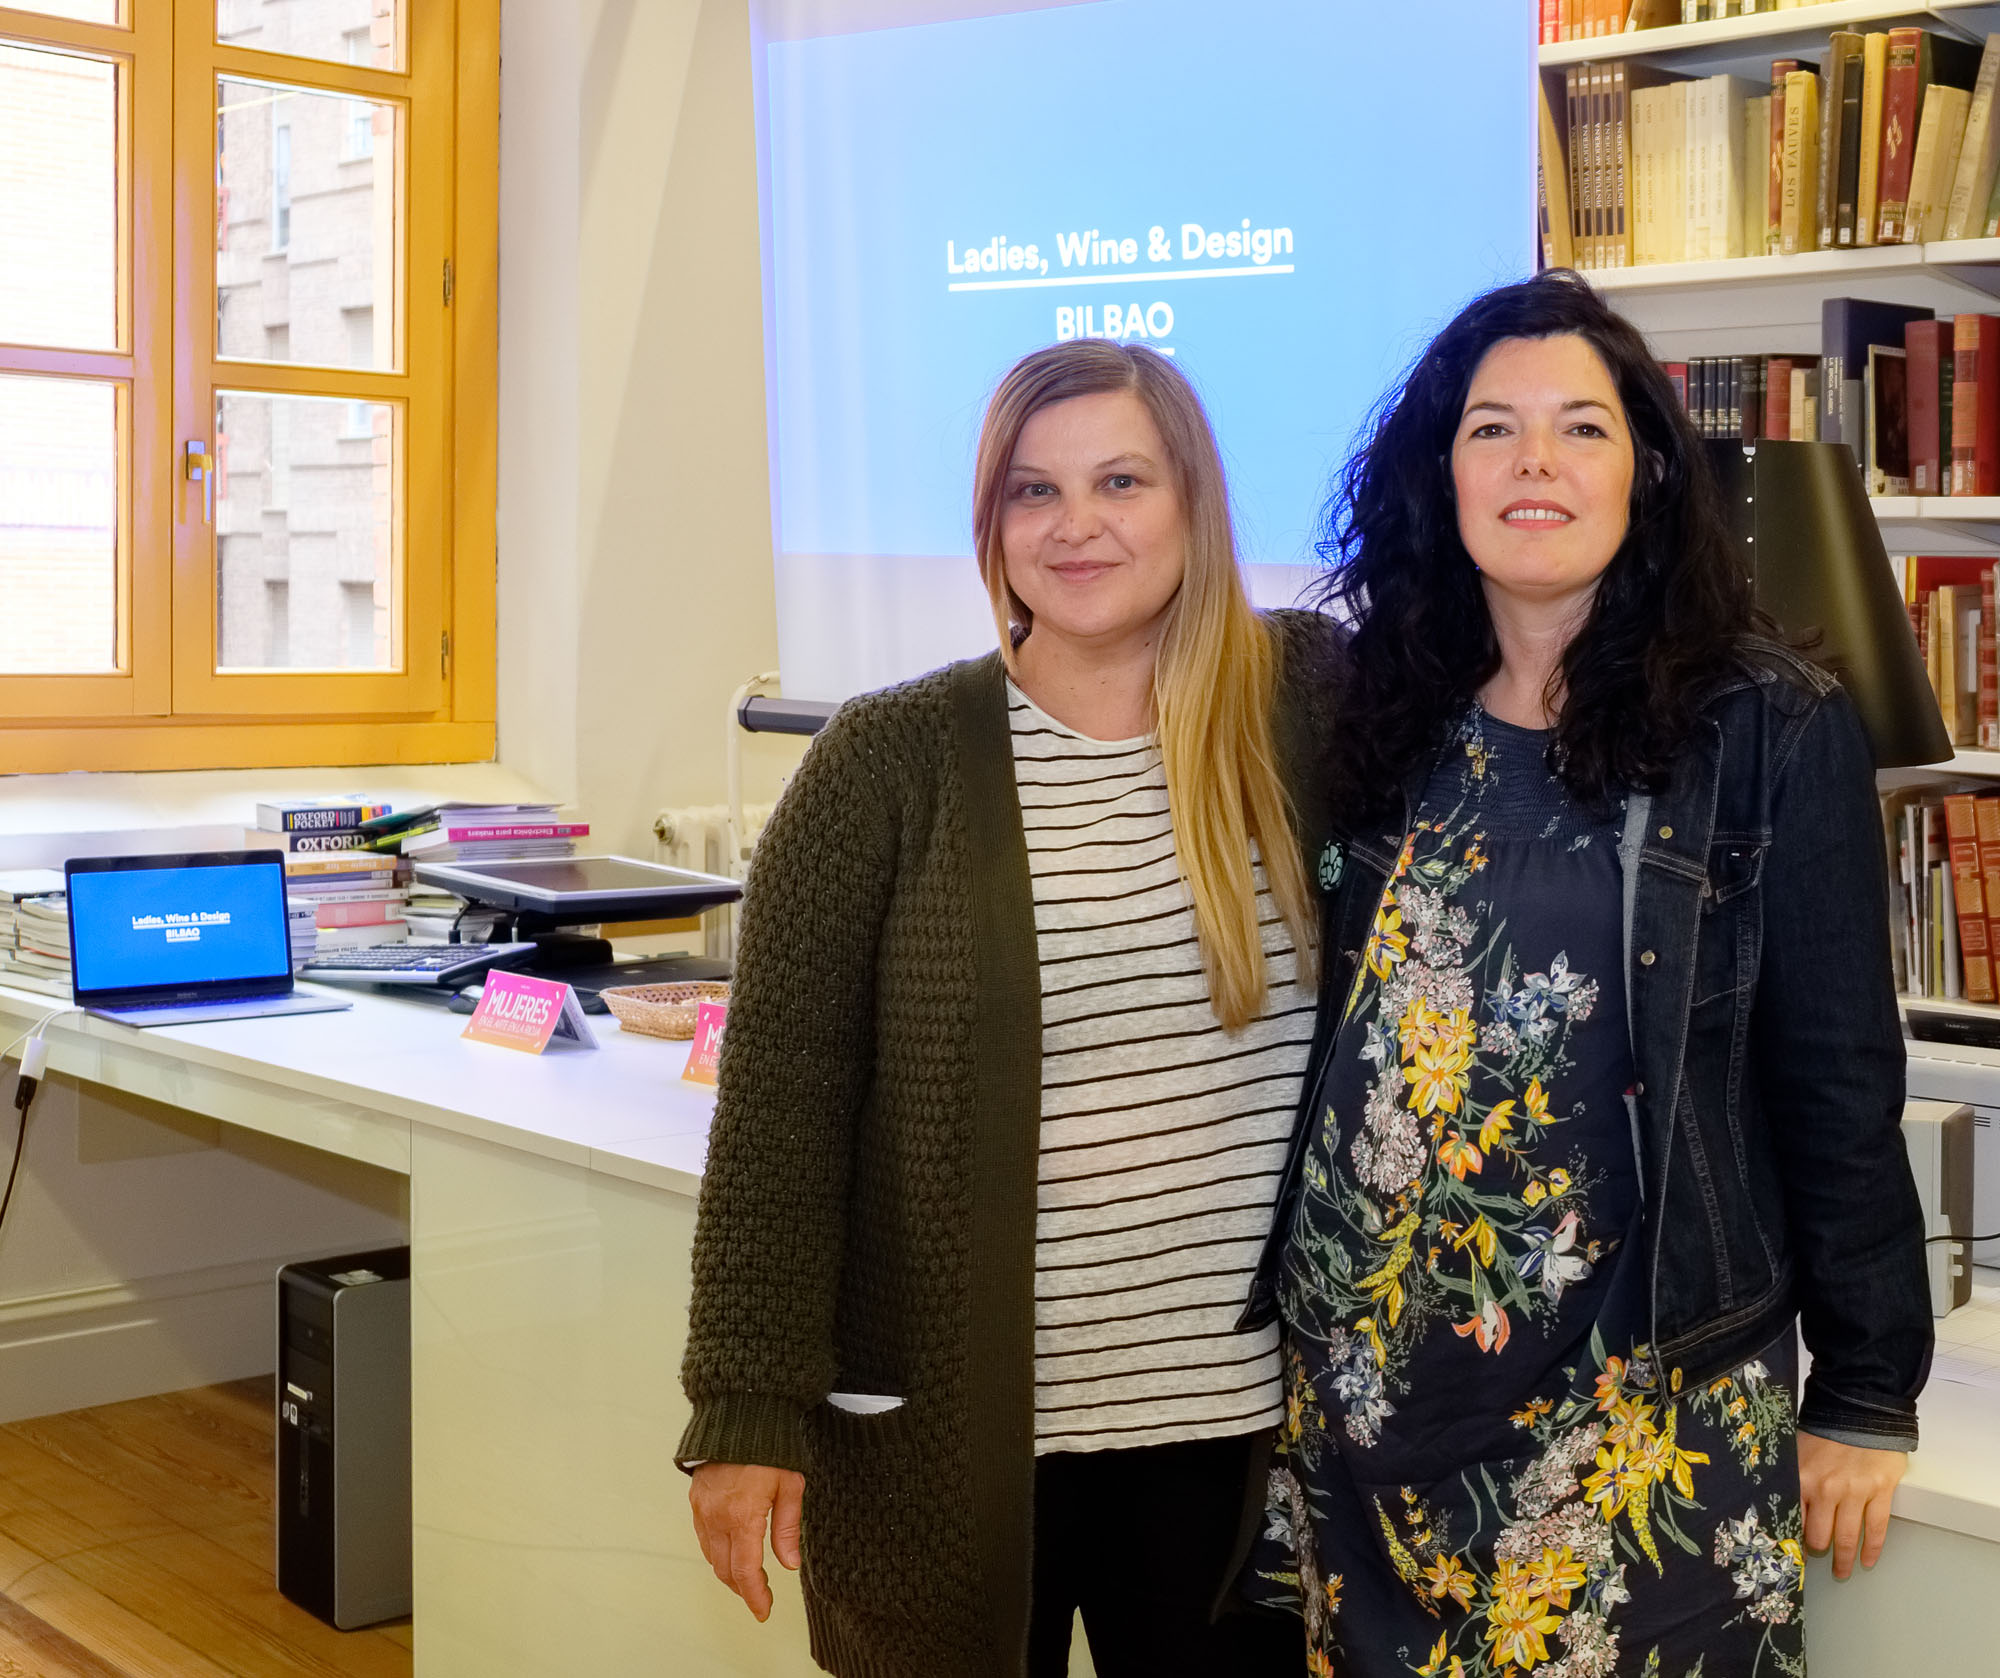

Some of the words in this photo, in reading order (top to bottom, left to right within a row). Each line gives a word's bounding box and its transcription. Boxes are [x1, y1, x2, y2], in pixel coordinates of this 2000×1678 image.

[1582, 123, 1590, 167] MODERNA
[1788, 105, 1800, 169] FAUVES
[1583, 170, 1591, 209] PINTURA
[1787, 177, 1797, 208] LOS
[947, 235, 1049, 276] Ladies,
[1057, 229, 1138, 268] Wine
[1148, 225, 1172, 263] &
[1181, 218, 1294, 265] Design
[1056, 301, 1175, 341] BILBAO
[293, 811, 335, 821] OXFORD
[294, 818, 335, 829] POCKET
[297, 834, 365, 852] OXFORD
[496, 828, 512, 836] para
[132, 914, 164, 925] Ladies,
[165, 913, 190, 923] Wine
[191, 912, 199, 921] &
[200, 911, 231, 922] Design
[166, 927, 200, 937] BILBAO
[484, 988, 552, 1025] MUJERES
